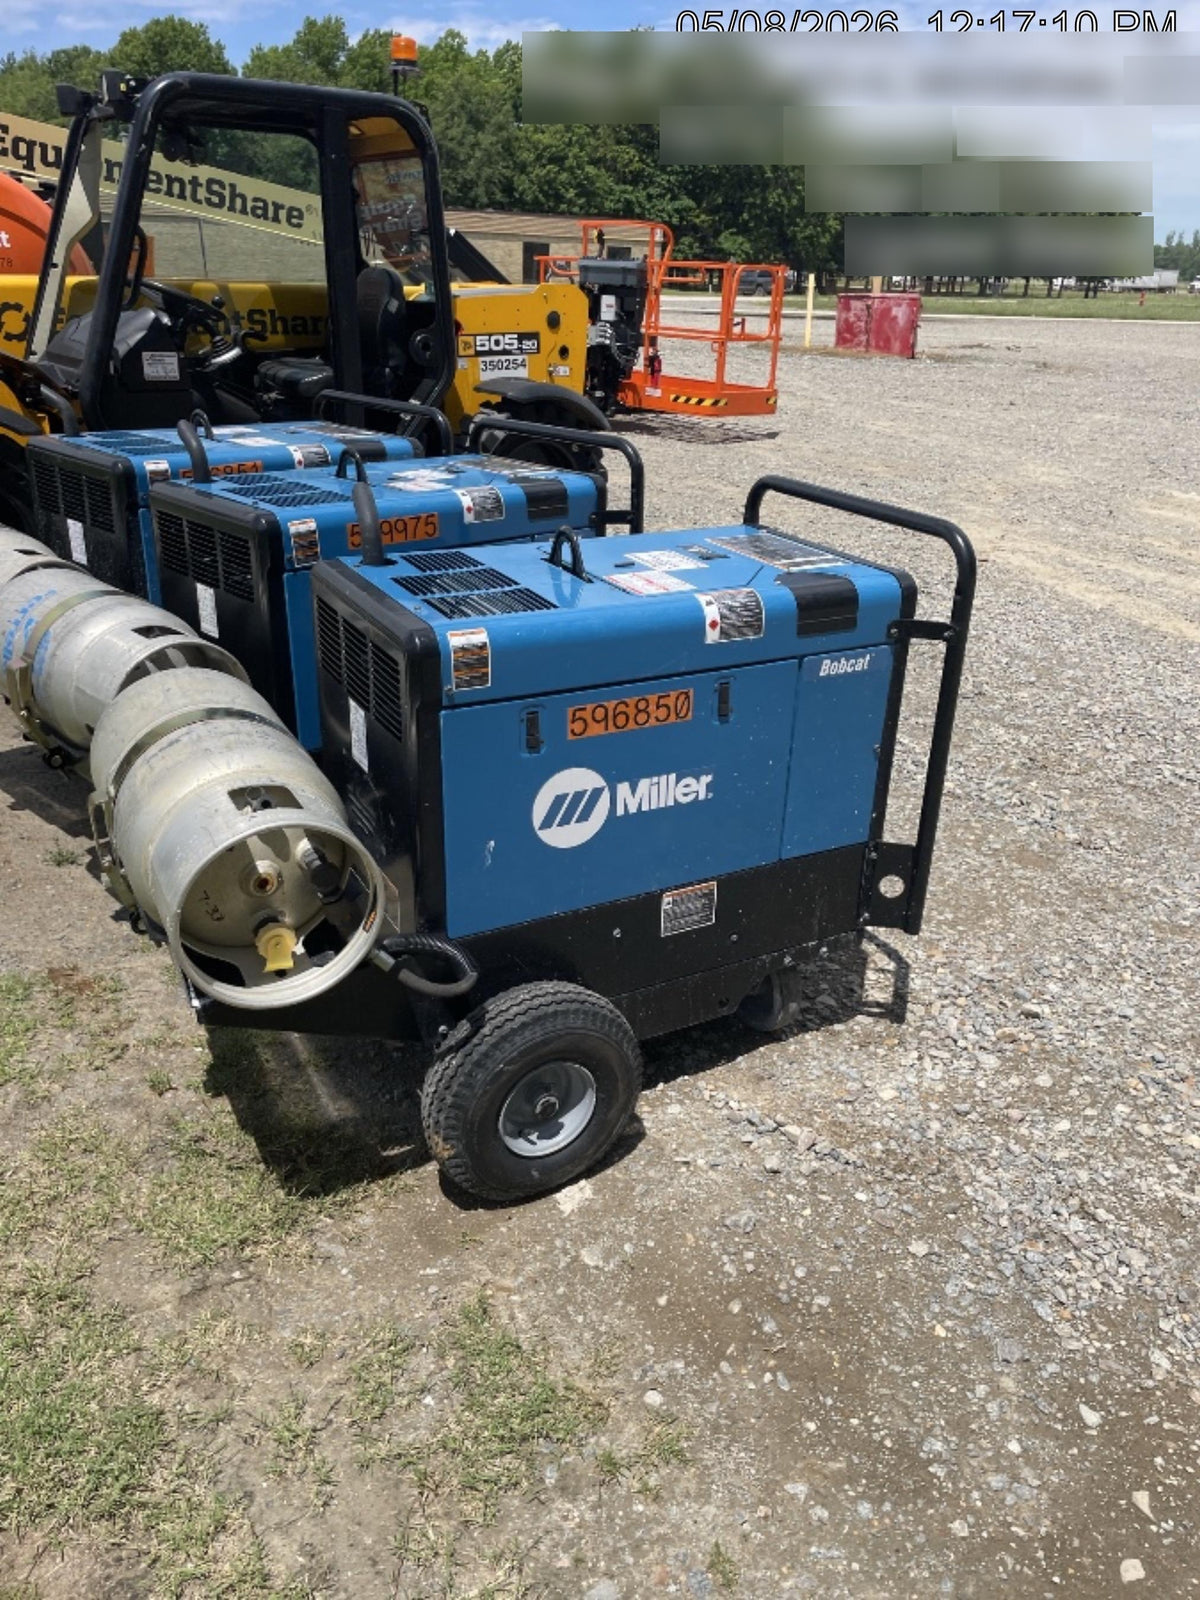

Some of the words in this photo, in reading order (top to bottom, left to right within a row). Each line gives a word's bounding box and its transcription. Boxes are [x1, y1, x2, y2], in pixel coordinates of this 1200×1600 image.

[480, 358, 527, 373] 350254
[350, 513, 438, 548] 59975
[819, 653, 871, 677] Bobcat
[570, 689, 692, 737] 596850
[616, 772, 713, 817] Miller
